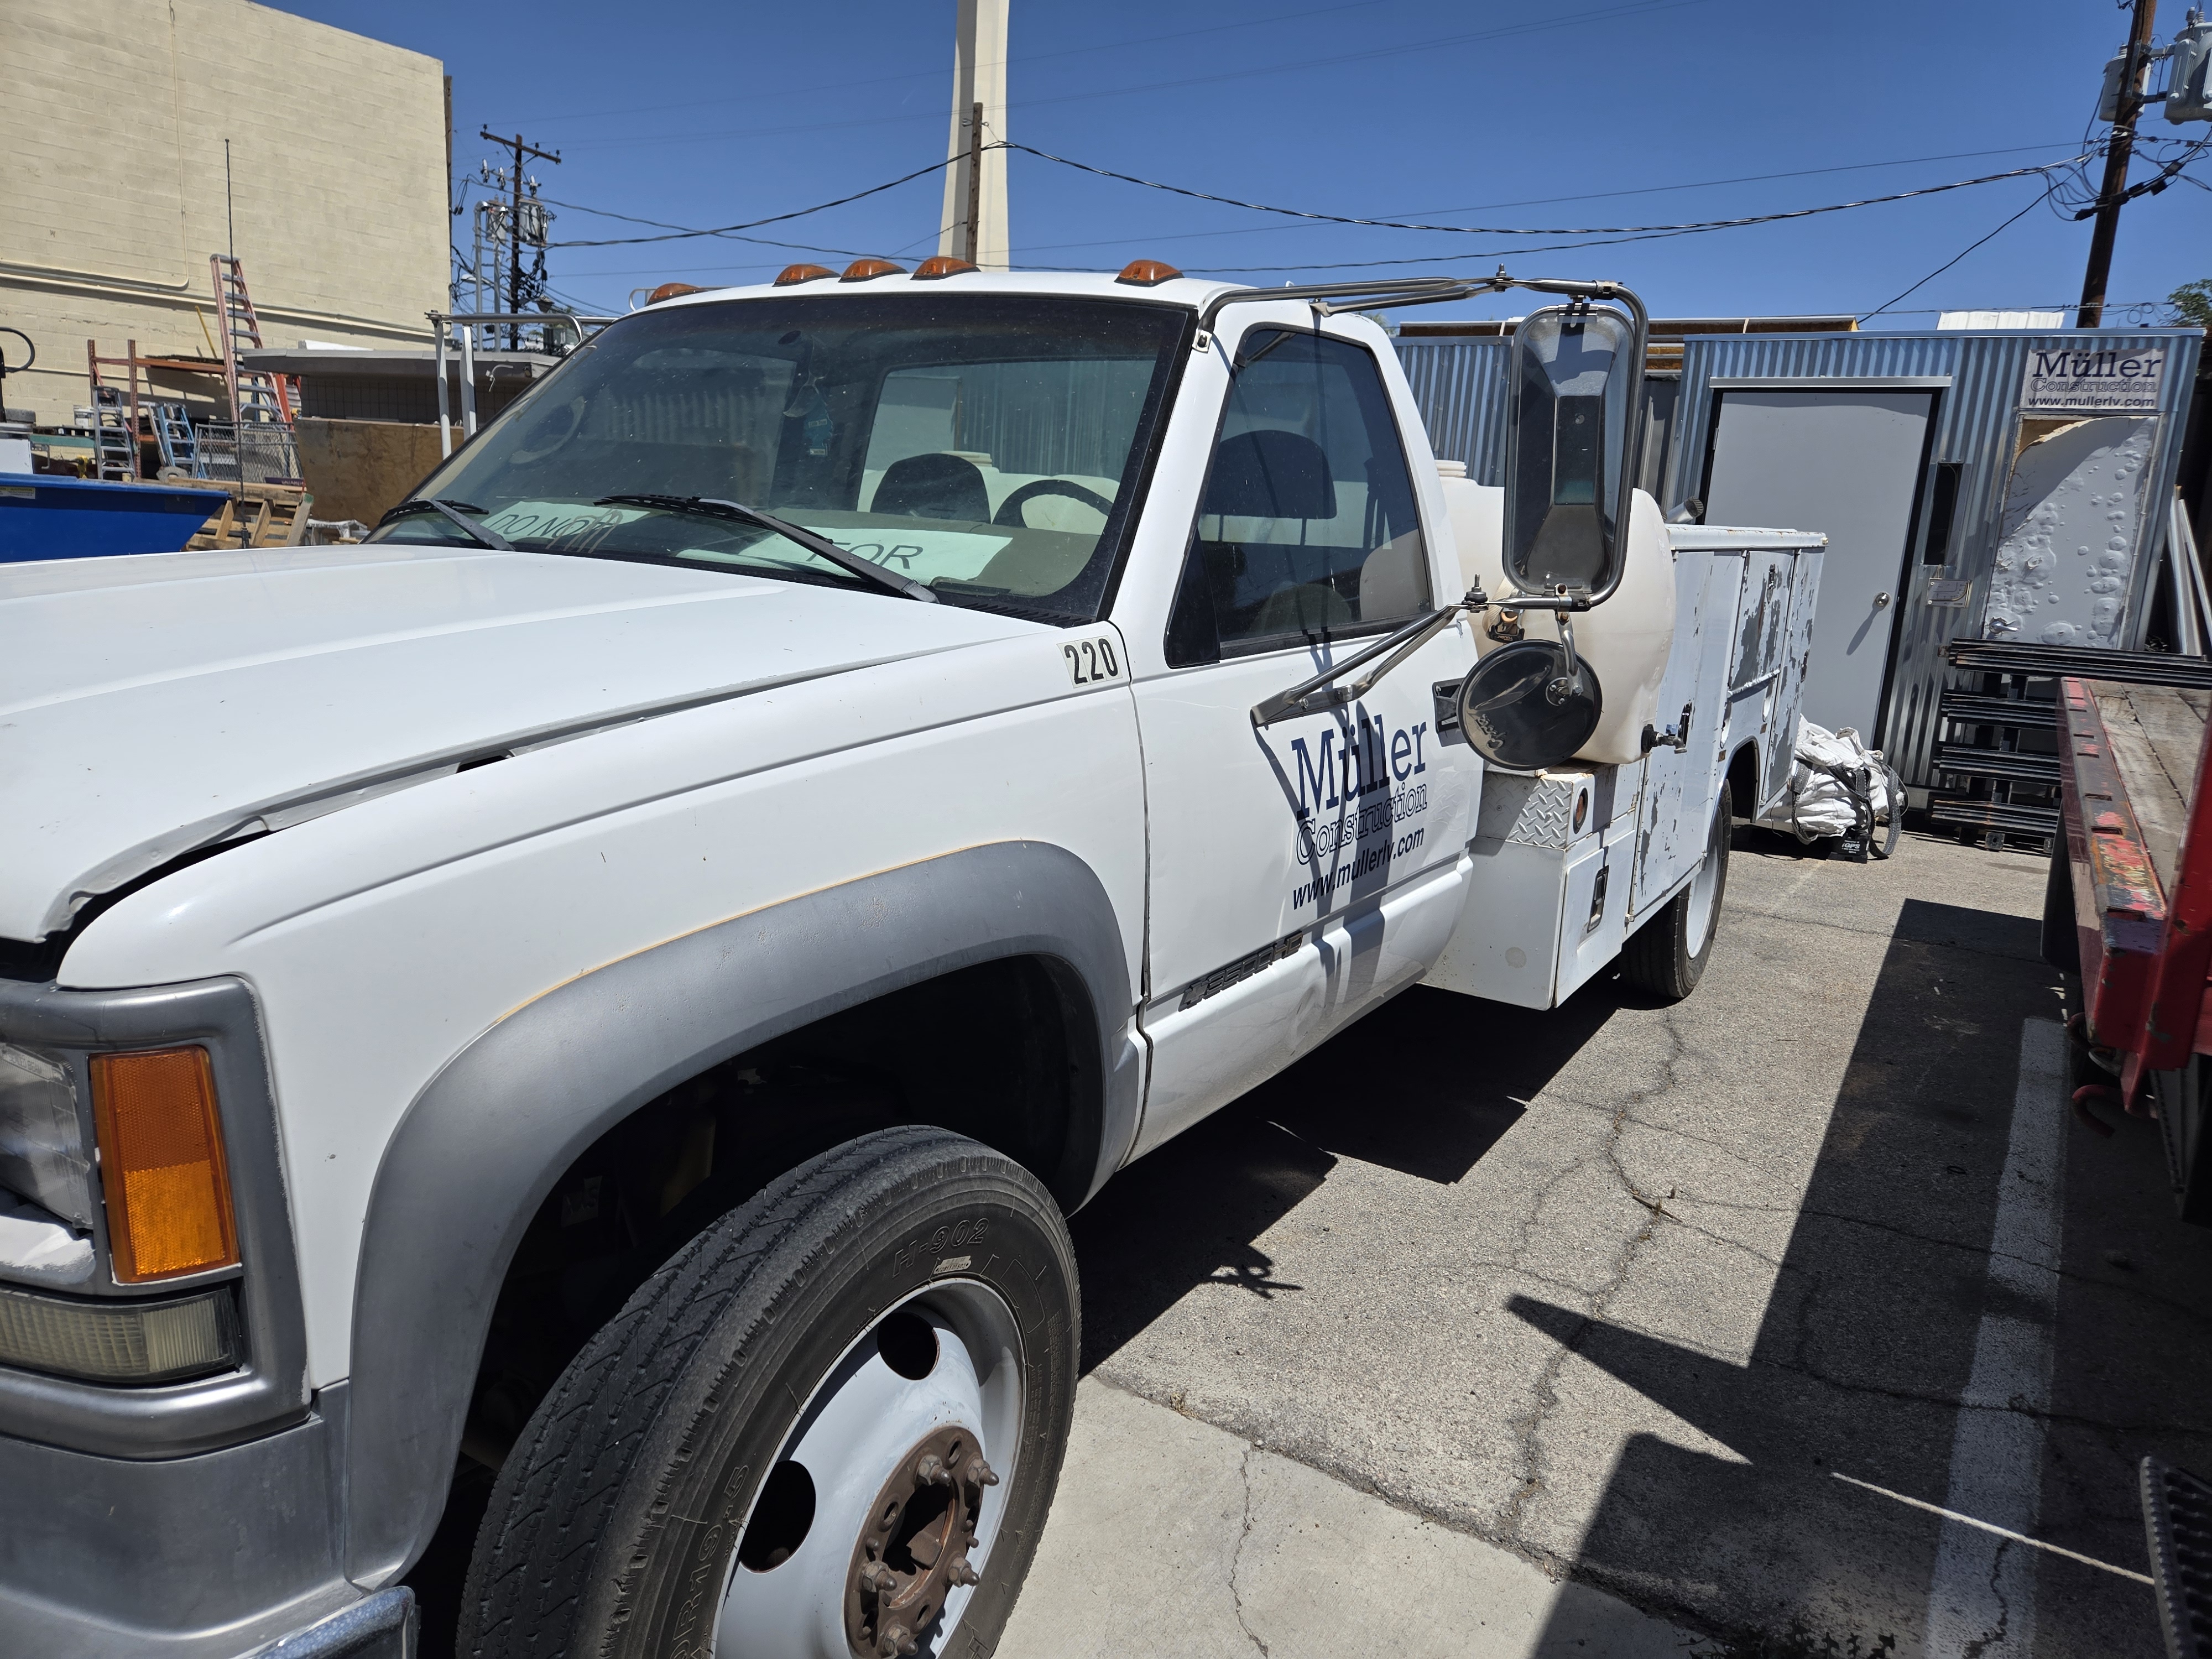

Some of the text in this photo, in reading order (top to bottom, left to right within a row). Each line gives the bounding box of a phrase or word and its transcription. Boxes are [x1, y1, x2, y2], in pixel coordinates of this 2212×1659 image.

[2030, 378, 2157, 393] Construction
[2032, 352, 2162, 378] Müller
[2028, 396, 2154, 407] www.mullerlv.com
[487, 514, 540, 535] DO
[1064, 638, 1118, 685] 220
[1290, 713, 1427, 821] Müller
[1296, 781, 1427, 865] Construction
[1293, 826, 1425, 910] www.mullerlv.com
[892, 1218, 990, 1279] H-902
